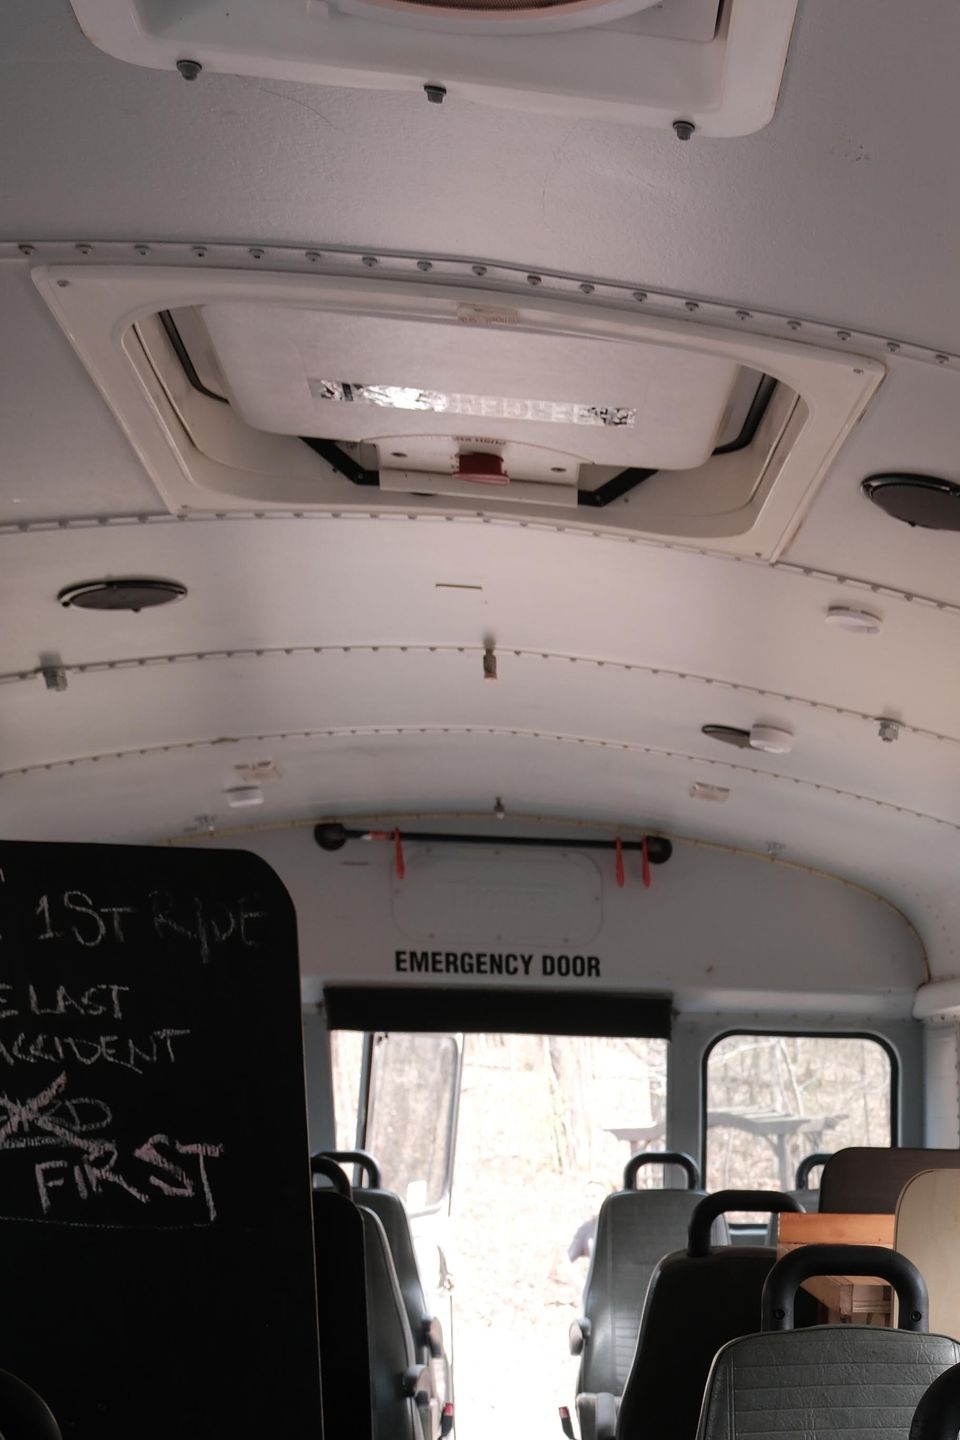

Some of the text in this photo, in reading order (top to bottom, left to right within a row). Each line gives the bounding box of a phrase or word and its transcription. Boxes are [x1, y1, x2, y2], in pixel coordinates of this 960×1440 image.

[394, 950, 601, 977] EMERGENCY DOOR
[30, 984, 129, 1020] LAST
[36, 1134, 224, 1221] FIRST
